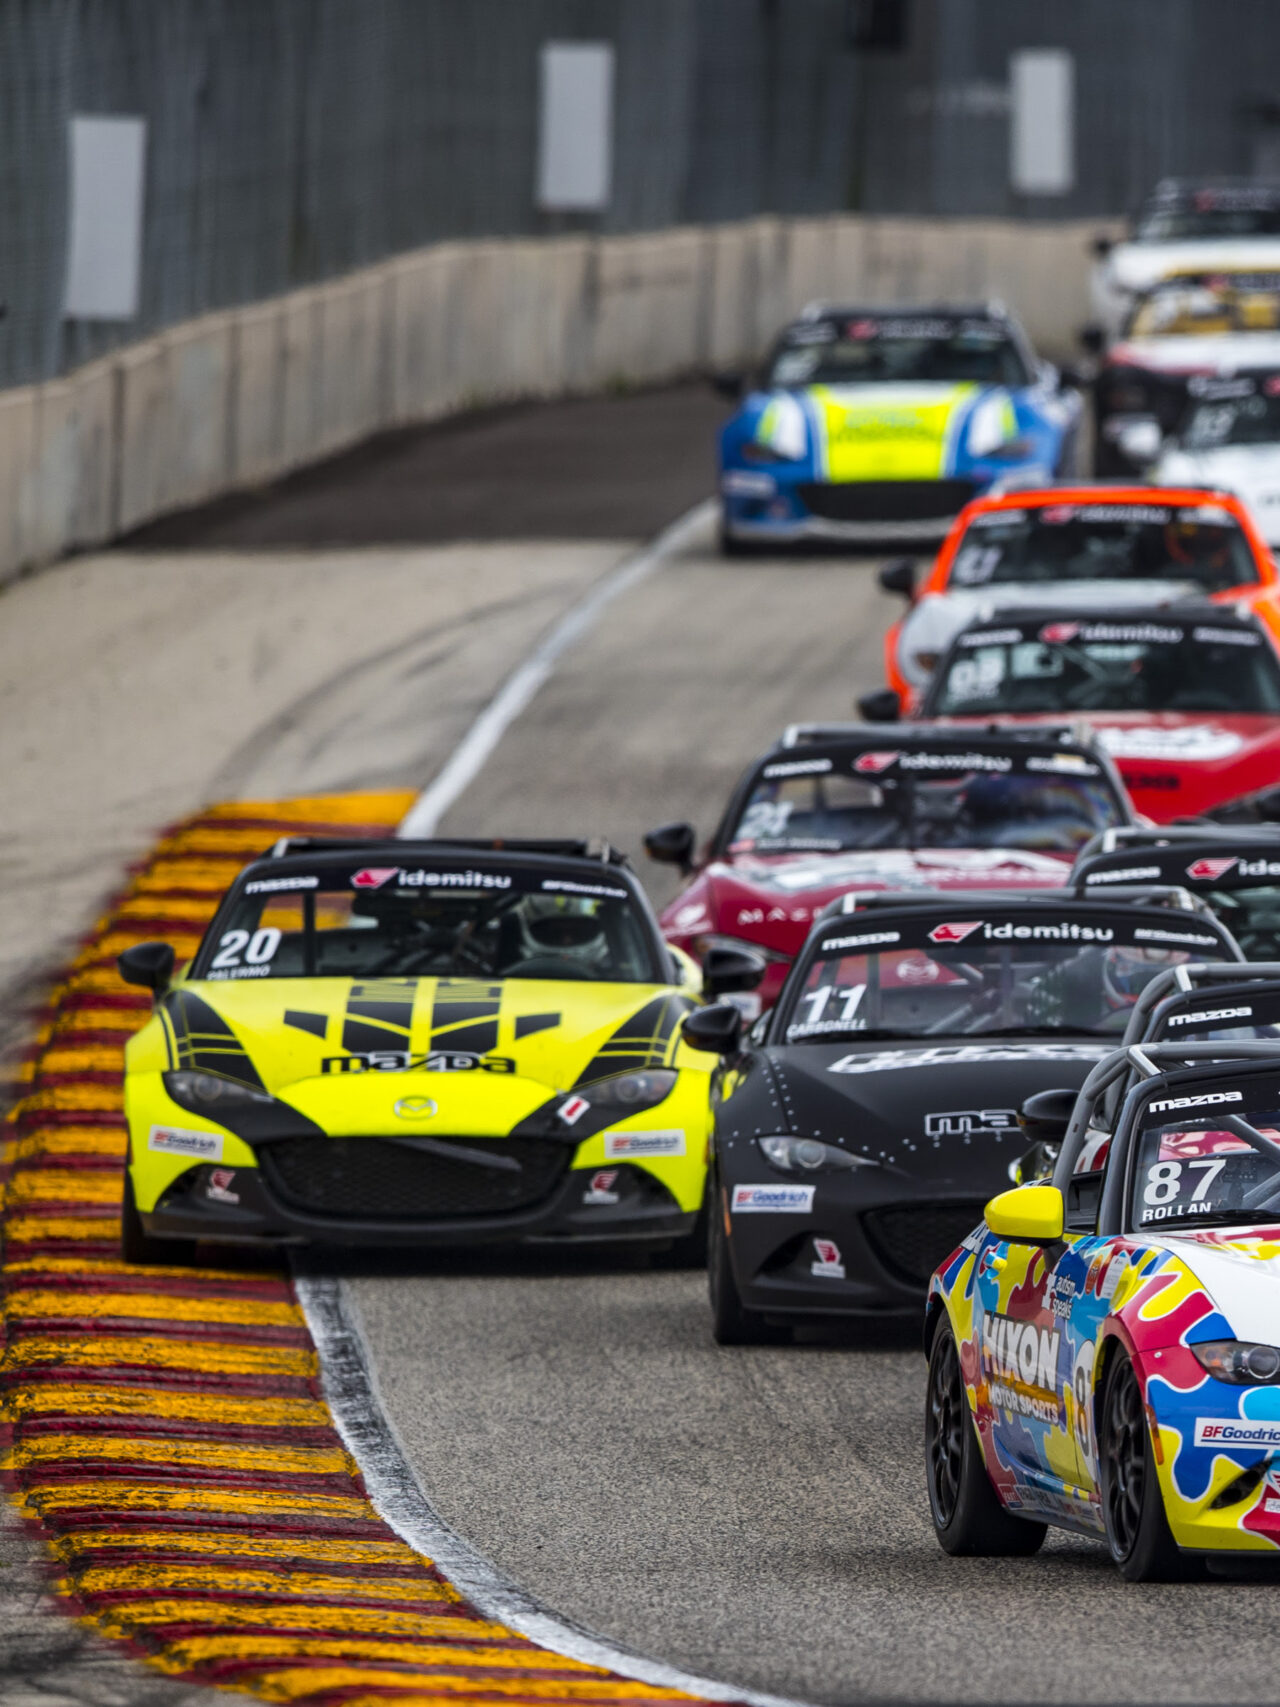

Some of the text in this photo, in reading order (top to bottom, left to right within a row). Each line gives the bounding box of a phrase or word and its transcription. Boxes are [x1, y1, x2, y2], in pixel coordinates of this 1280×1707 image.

[399, 870, 512, 888] idemitsu
[983, 922, 1114, 941] idemitsu
[211, 926, 282, 969] 20
[804, 983, 867, 1024] 11
[1149, 1091, 1243, 1113] mazda
[1143, 1159, 1226, 1206] 87
[1142, 1202, 1212, 1222] ROLLAN
[1055, 1274, 1076, 1297] autism
[1052, 1298, 1073, 1320] speaks
[983, 1315, 1060, 1392] HIXON
[988, 1383, 1059, 1425] MOTOR SPORTS
